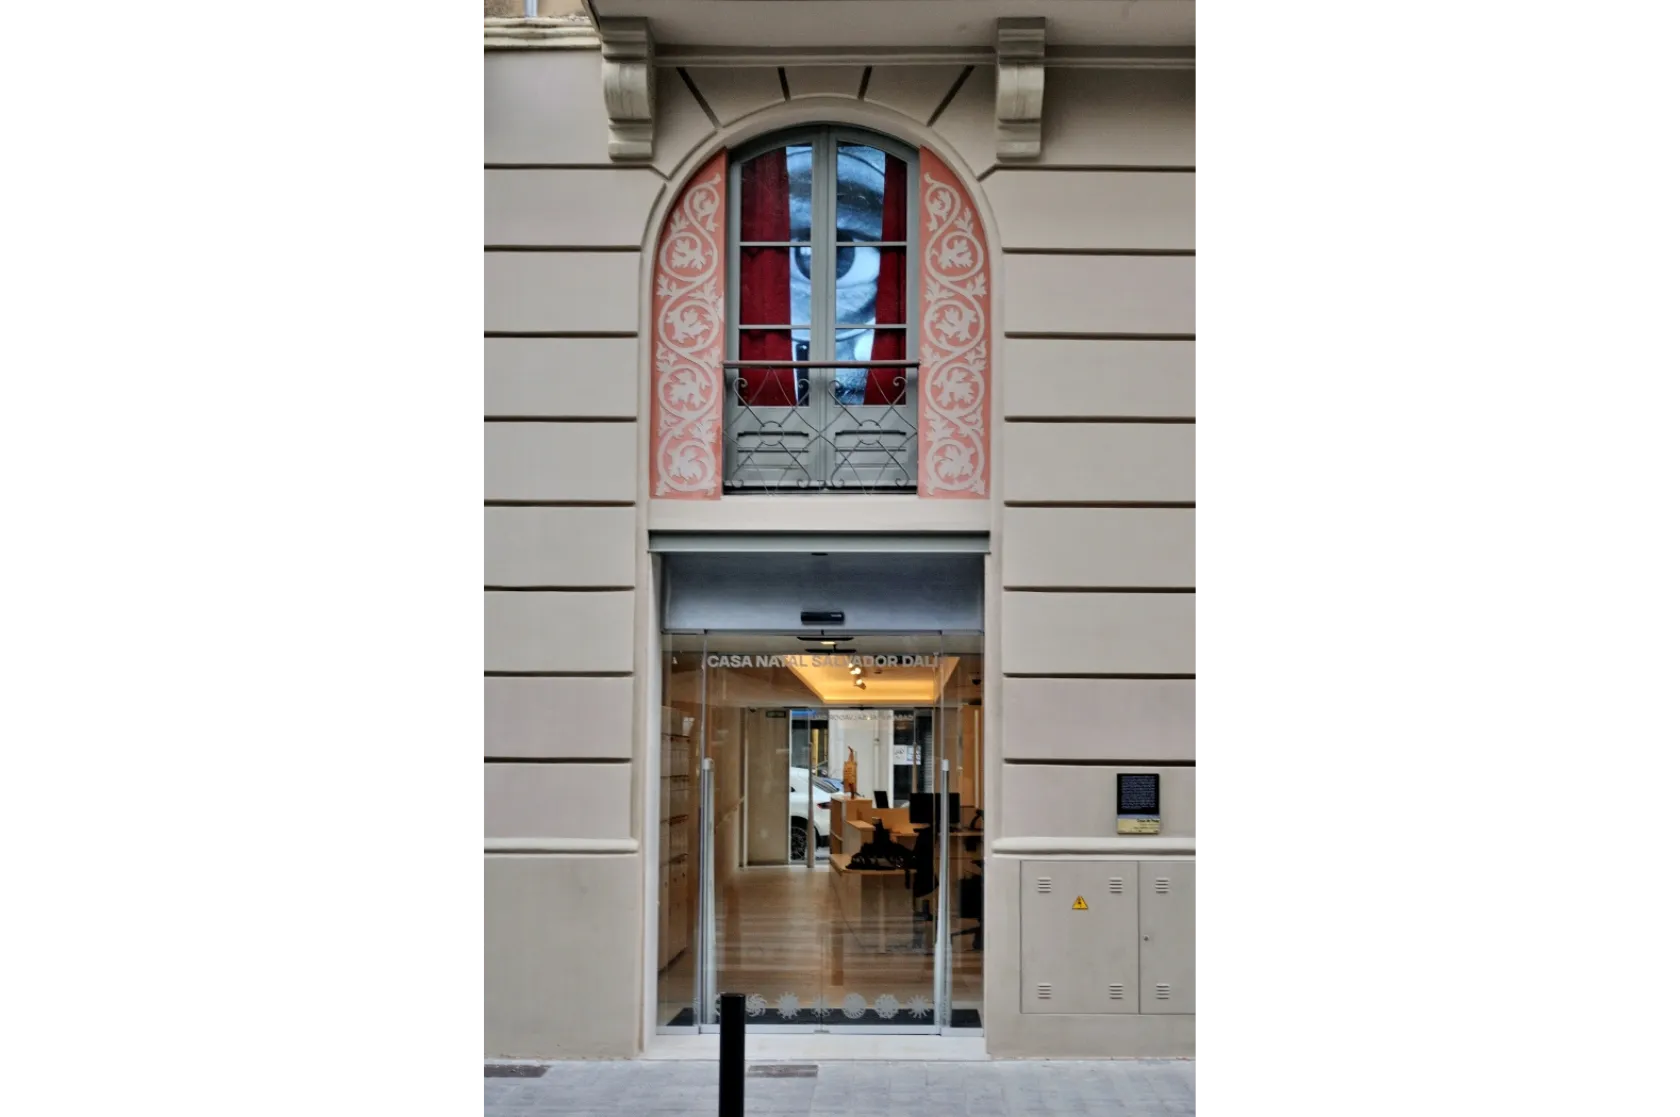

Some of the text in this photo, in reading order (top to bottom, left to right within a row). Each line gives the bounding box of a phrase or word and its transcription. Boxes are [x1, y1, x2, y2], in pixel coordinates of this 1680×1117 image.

[707, 655, 753, 667] CASA
[756, 655, 808, 667] NATAL
[812, 655, 899, 667] SALVADOR
